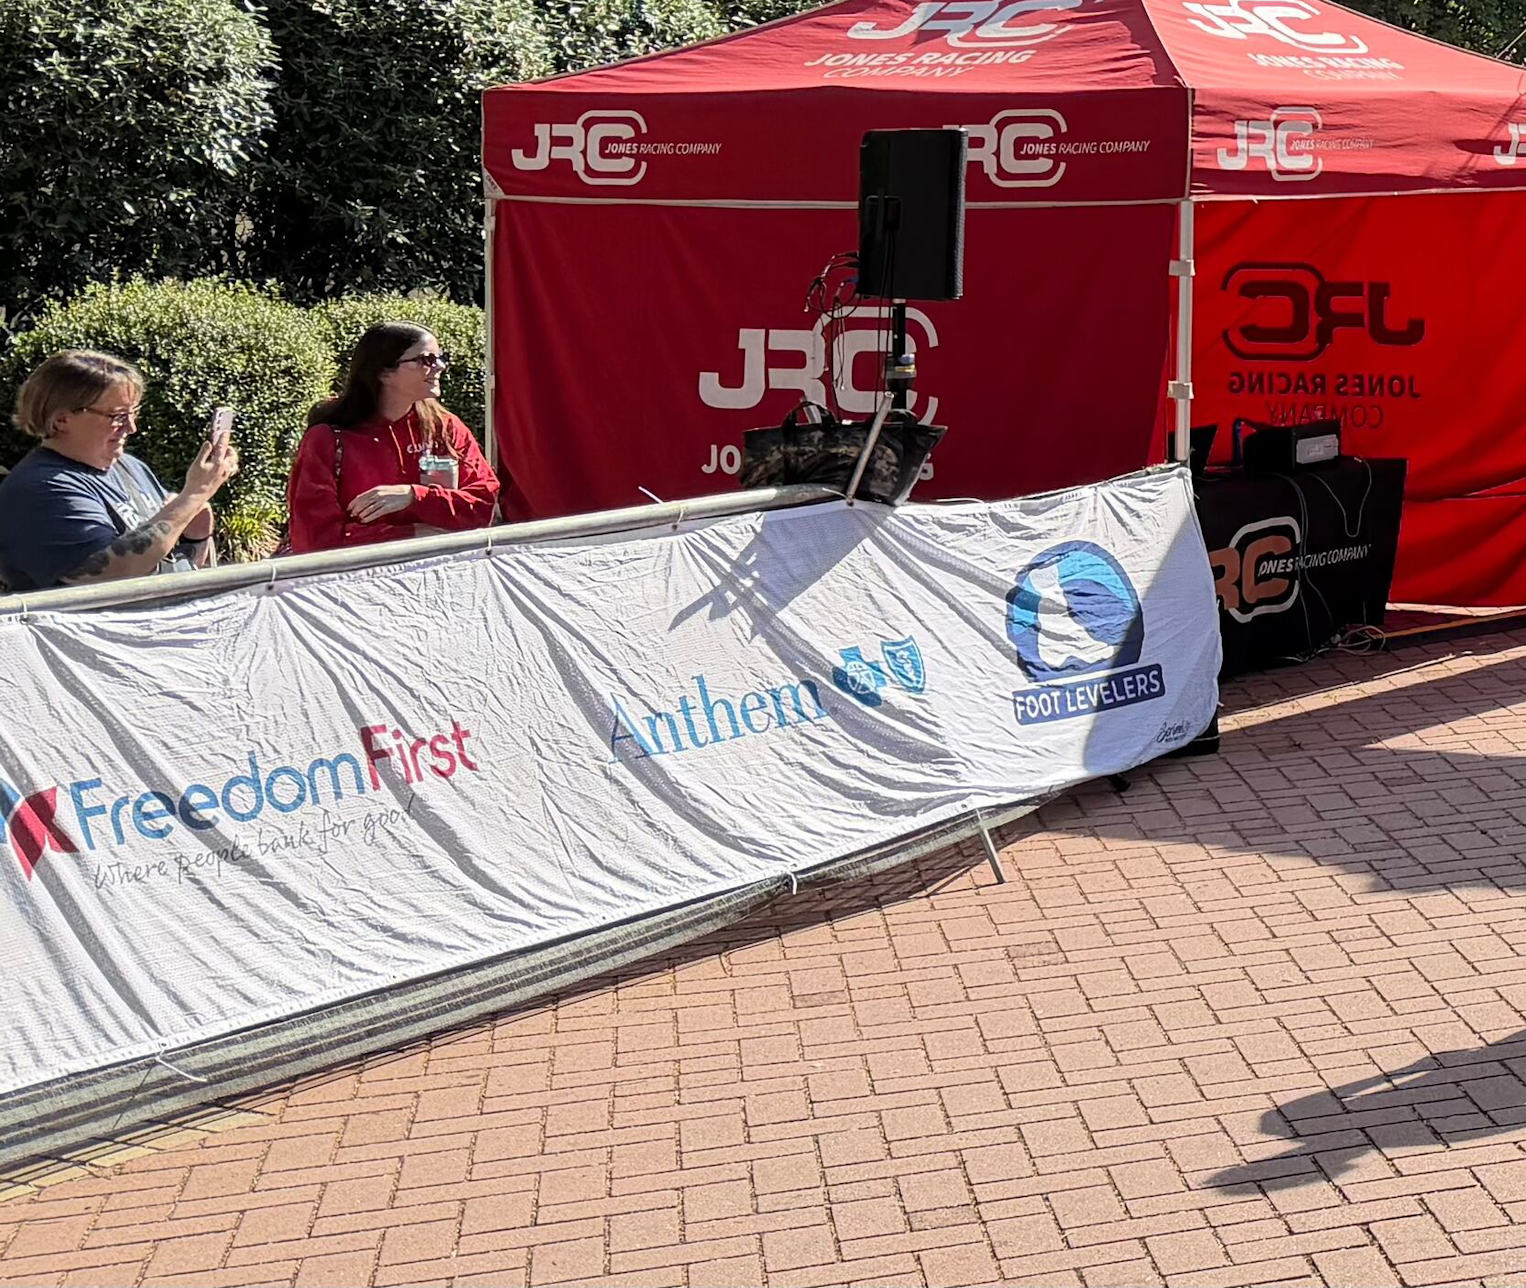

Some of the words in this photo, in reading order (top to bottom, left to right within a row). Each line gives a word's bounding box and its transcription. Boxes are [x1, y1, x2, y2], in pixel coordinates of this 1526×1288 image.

[804, 52, 910, 67] JONES
[911, 50, 1037, 66] RACING
[823, 65, 975, 79] COMPANY
[511, 109, 648, 186] JRC
[604, 142, 639, 154] JONES
[639, 143, 675, 155] RACING
[675, 143, 722, 155] COMPANY
[942, 108, 1068, 188] RC
[1020, 143, 1056, 155] JONES
[1058, 142, 1098, 155] RACING
[1099, 140, 1151, 154] COMPANY
[1216, 106, 1323, 182] JRC
[1290, 139, 1315, 150] JONES
[1209, 516, 1301, 623] RC
[608, 673, 828, 764] Anthem
[1016, 692, 1063, 721] FOOT
[1064, 667, 1162, 713] LEVELERS
[69, 720, 481, 851] FreedomFirst
[94, 860, 168, 889] Where
[174, 838, 252, 885] people
[256, 825, 312, 859] bank
[318, 813, 354, 852] for
